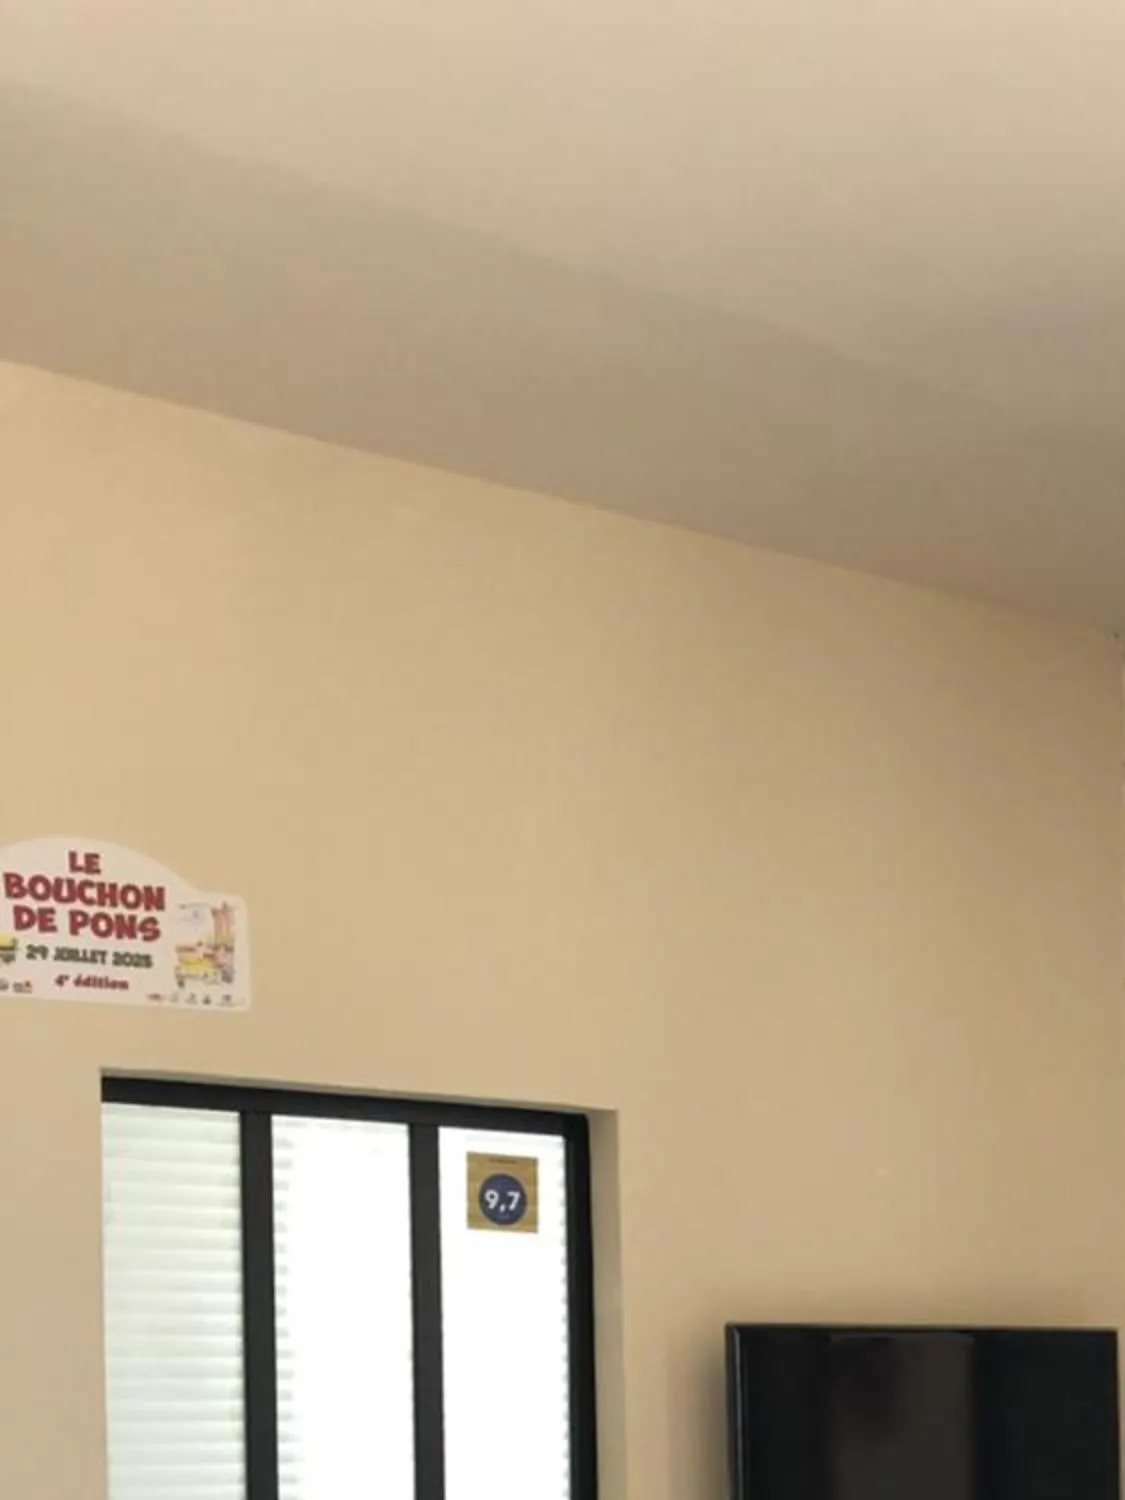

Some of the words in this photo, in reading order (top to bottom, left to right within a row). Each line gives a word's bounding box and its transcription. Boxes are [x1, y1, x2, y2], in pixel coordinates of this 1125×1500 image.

[69, 851, 102, 875] LE
[3, 872, 165, 911] BOUCHON
[13, 905, 58, 933] DE
[69, 910, 161, 942] PONS
[53, 947, 108, 965] JUILLET
[485, 1189, 521, 1212] 9,7
